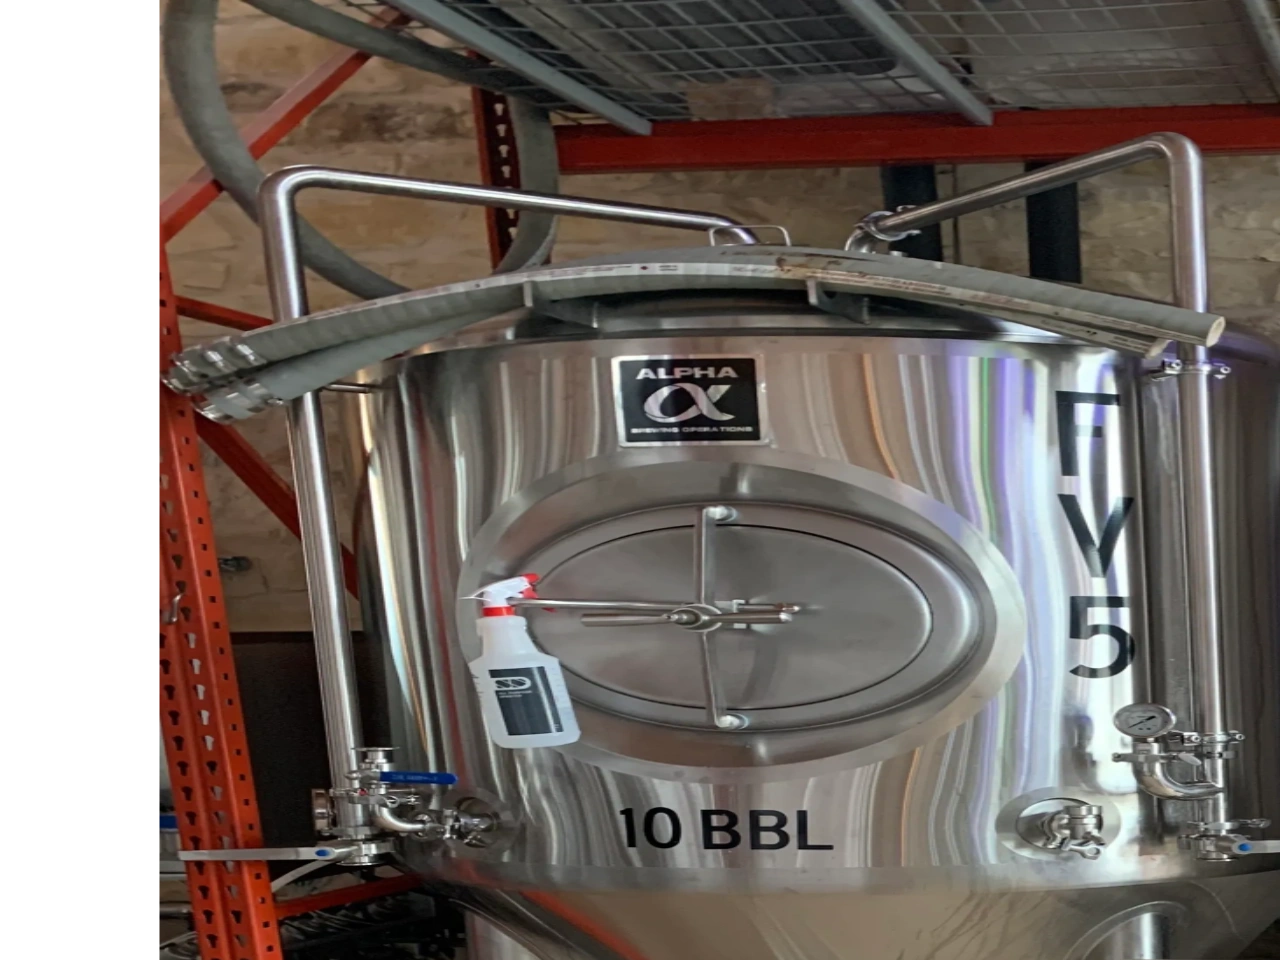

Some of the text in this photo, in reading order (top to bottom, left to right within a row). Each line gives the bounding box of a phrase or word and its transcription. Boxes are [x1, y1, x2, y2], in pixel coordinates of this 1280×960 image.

[635, 366, 738, 380] ALPHA
[681, 425, 754, 433] OPERATIONS
[619, 806, 834, 851] 10 BBL
